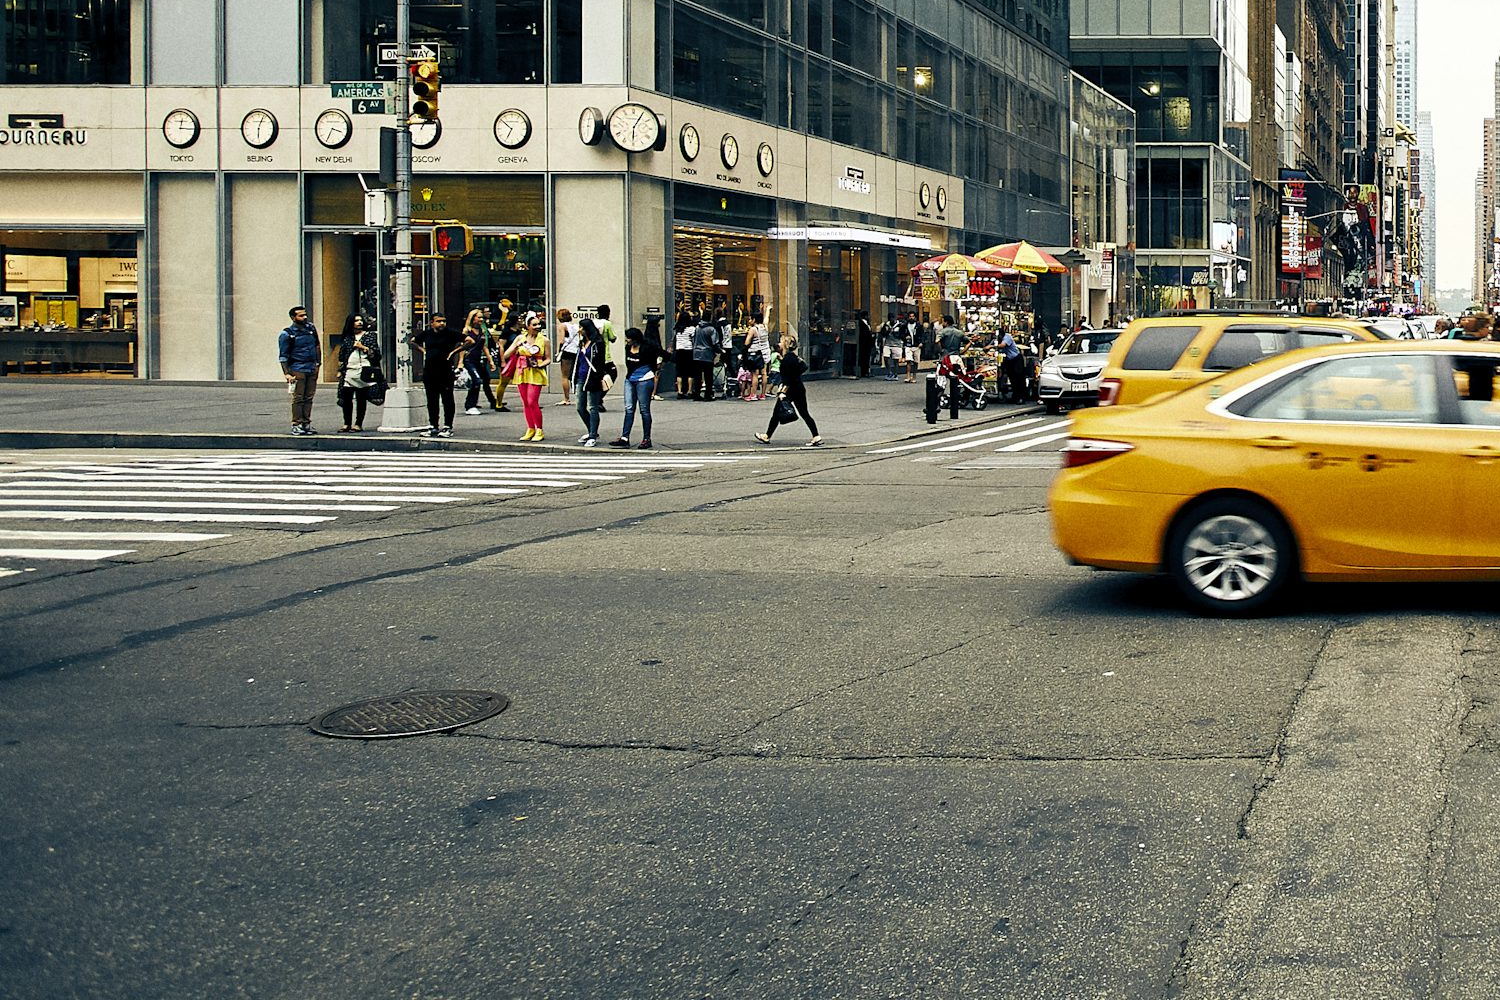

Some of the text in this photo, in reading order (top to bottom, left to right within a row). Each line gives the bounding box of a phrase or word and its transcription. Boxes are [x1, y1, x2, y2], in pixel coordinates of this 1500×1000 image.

[386, 50, 430, 59] ON WAY
[337, 88, 384, 97] AMERICAS
[358, 100, 367, 113] 6
[498, 156, 529, 164] GENEVA
[681, 166, 698, 176] LONDON
[1411, 208, 1419, 276] TUSSAUDS
[1193, 271, 1209, 279] NOW
